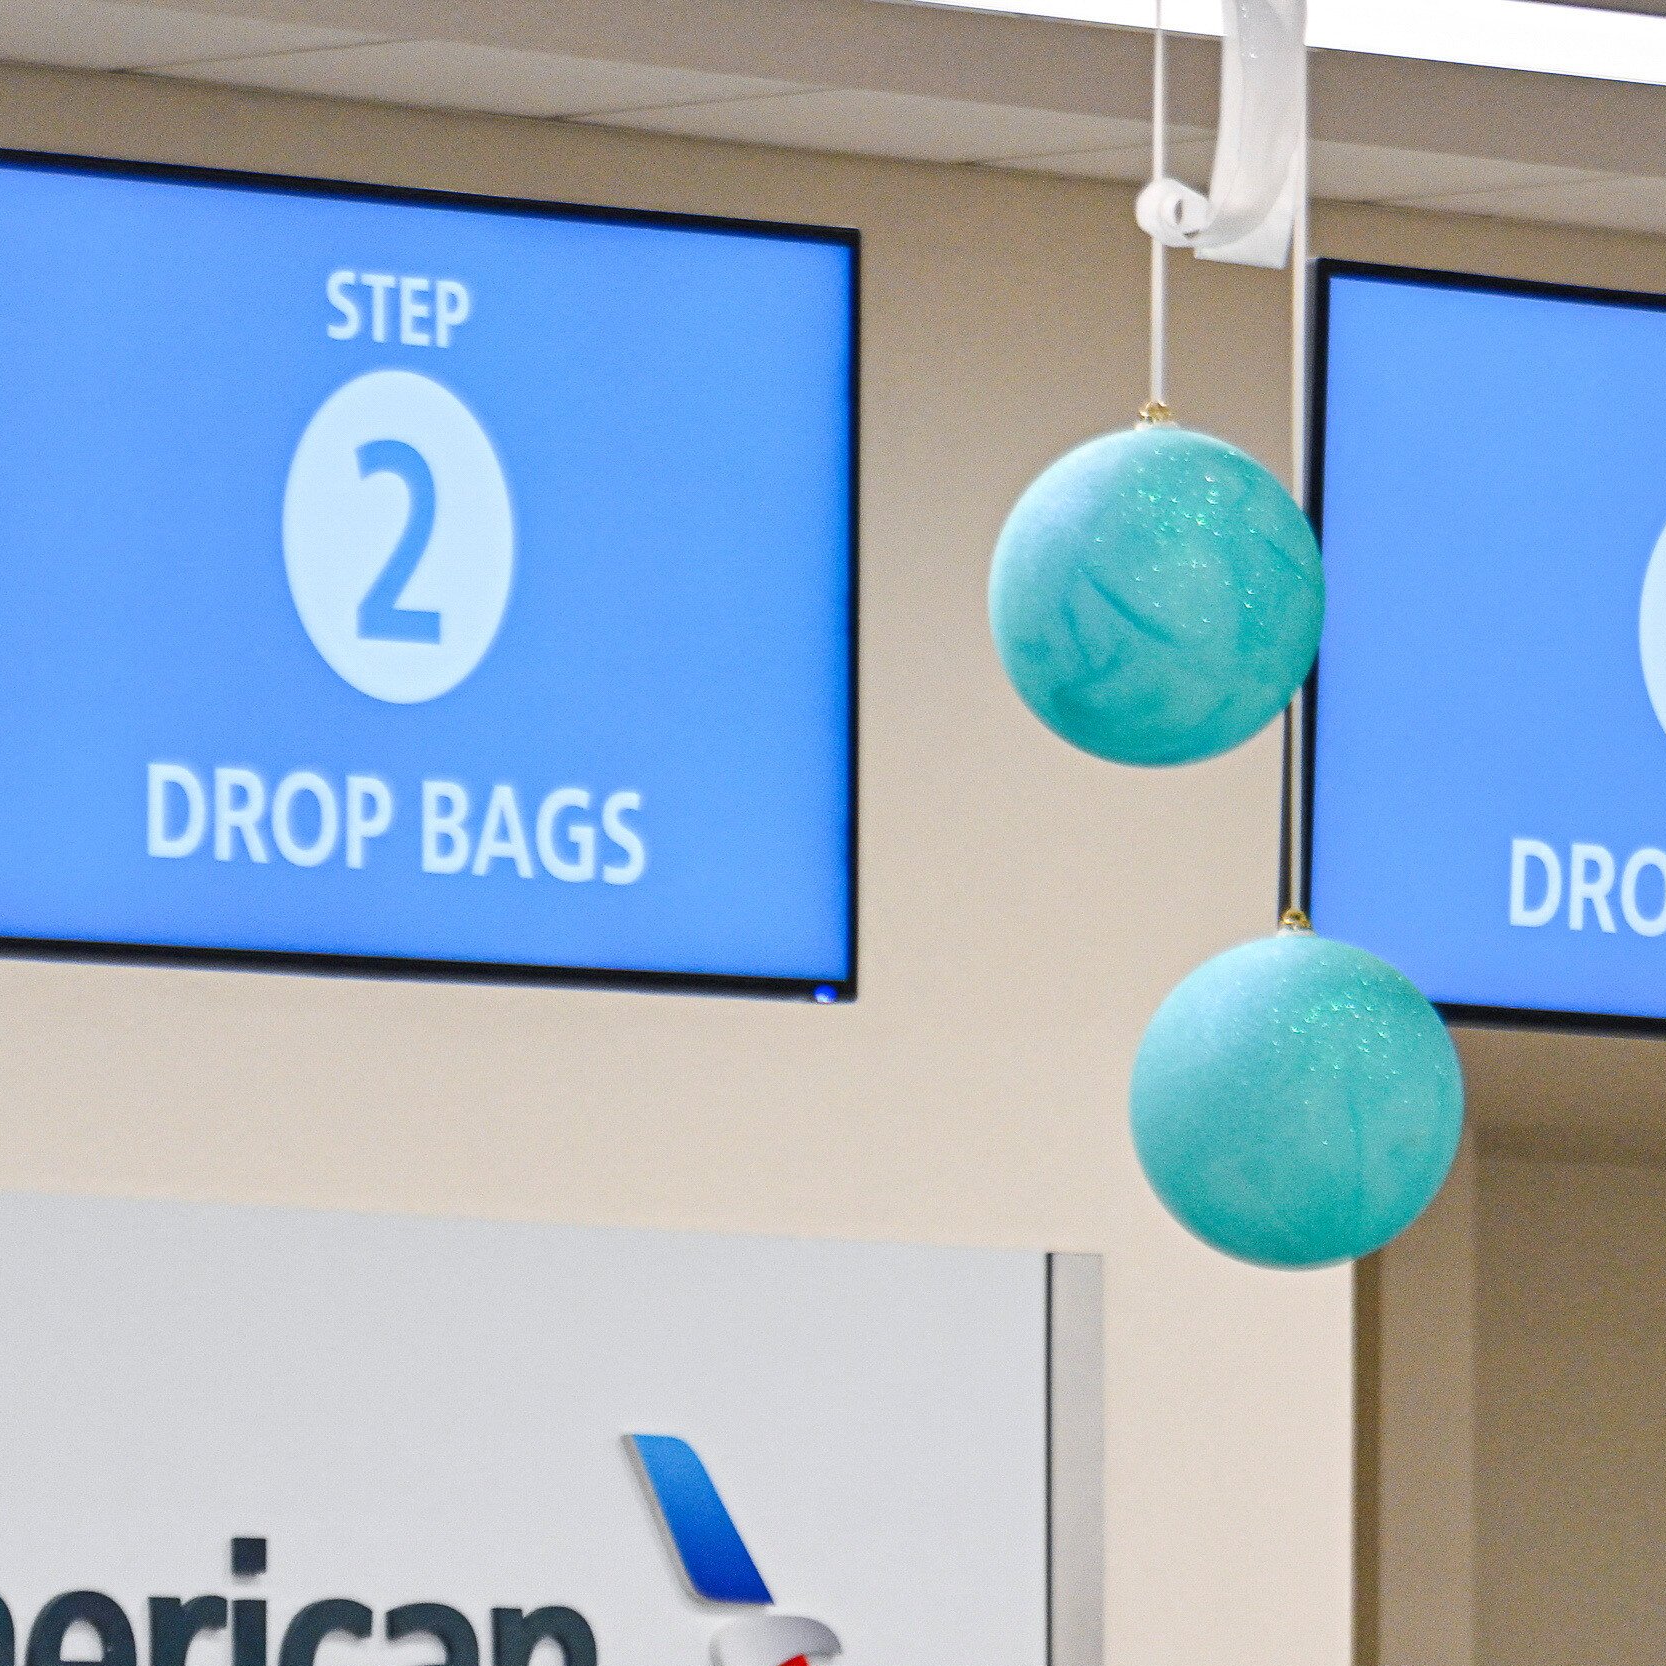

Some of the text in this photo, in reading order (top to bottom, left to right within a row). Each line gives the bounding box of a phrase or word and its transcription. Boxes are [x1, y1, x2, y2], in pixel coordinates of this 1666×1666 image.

[327, 270, 471, 347] STEP
[357, 439, 441, 643] 2
[148, 763, 646, 884] DROP BAGS
